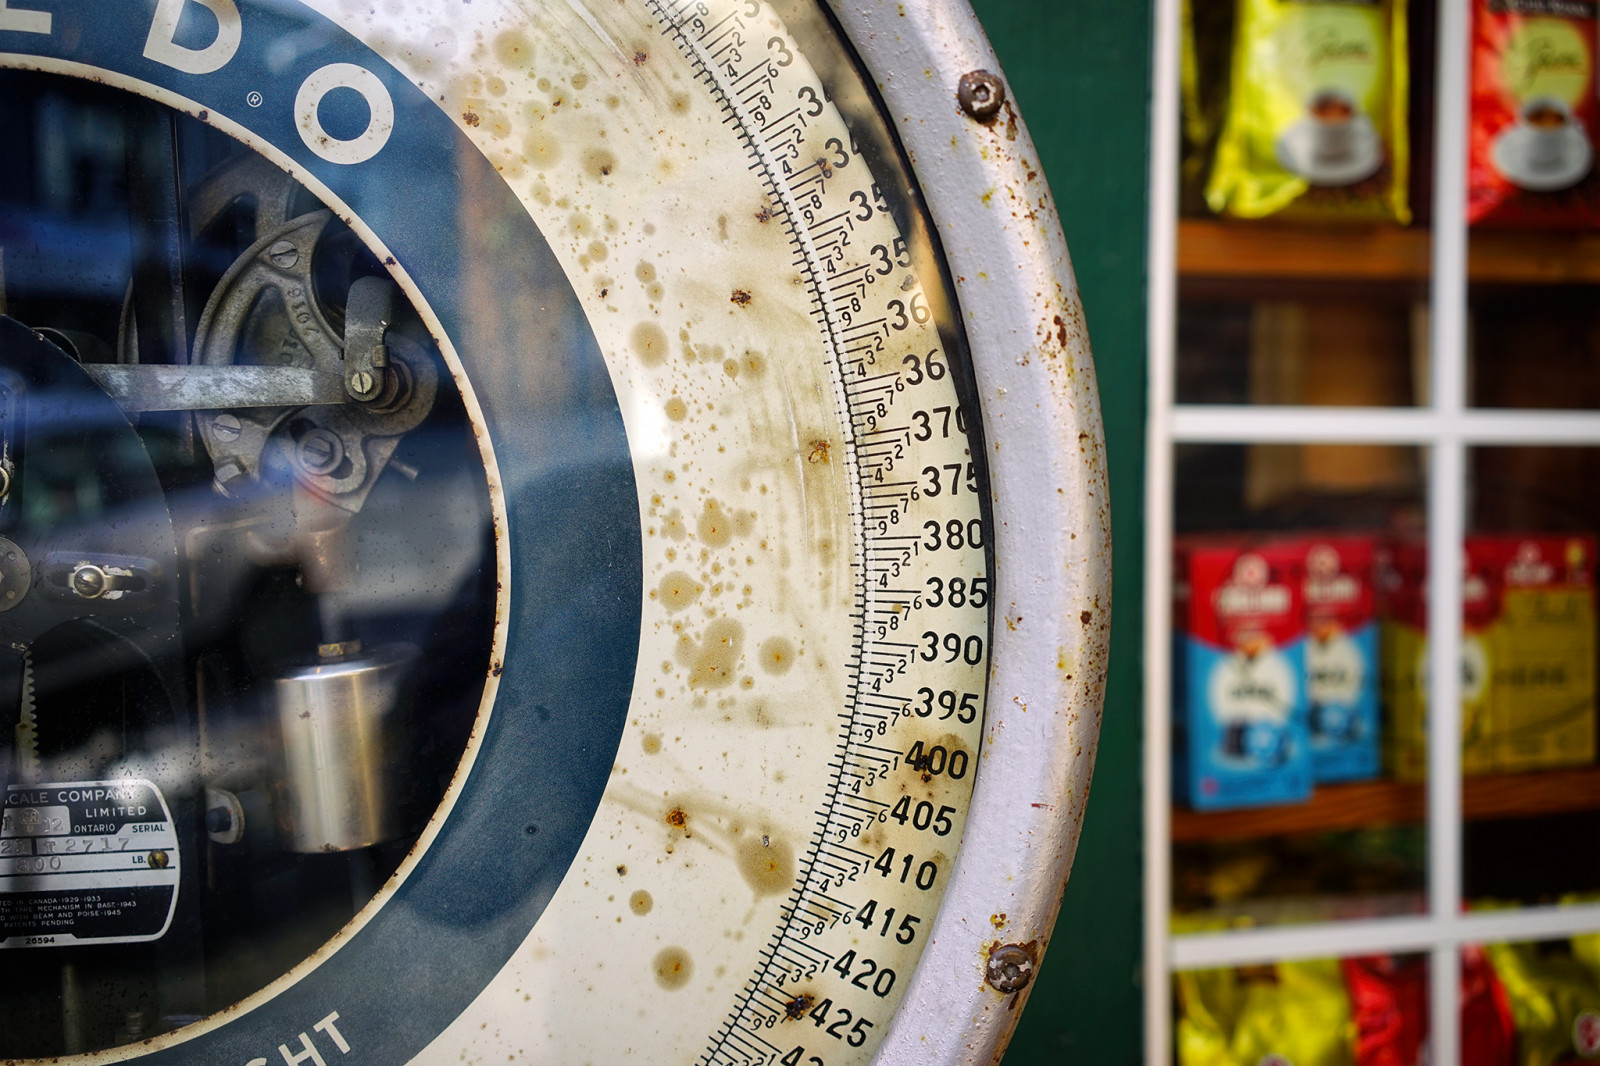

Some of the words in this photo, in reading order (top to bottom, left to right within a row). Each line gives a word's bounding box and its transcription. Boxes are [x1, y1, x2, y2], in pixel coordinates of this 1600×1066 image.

[697, 3, 709, 16] 8
[693, 18, 705, 33] 9
[735, 16, 745, 29] 1
[732, 31, 745, 47] 2
[730, 48, 742, 62] 3
[727, 63, 738, 78] 4
[767, 63, 779, 78] 6
[762, 79, 774, 94] 7
[759, 95, 772, 110] 8
[754, 111, 766, 126] 9
[798, 114, 807, 127] 1
[792, 128, 805, 144] 2
[787, 144, 799, 159] 3
[783, 160, 792, 174] 4
[816, 179, 825, 194] 7
[811, 194, 822, 209] 8
[804, 210, 814, 225] 9
[845, 217, 854, 231] 1
[839, 231, 850, 246] 2
[833, 245, 843, 260] 3
[826, 259, 836, 274] 4
[865, 268, 875, 284] 6
[857, 284, 866, 299] 7
[851, 297, 861, 312] 8
[887, 293, 932, 330] 36
[842, 312, 852, 326] 9
[883, 323, 890, 337] 1
[874, 336, 884, 351] 2
[865, 350, 875, 365] 3
[858, 363, 866, 378] 4
[902, 348, 945, 386] 36
[895, 377, 905, 392] 6
[885, 390, 894, 405] 7
[877, 403, 886, 418] 8
[867, 415, 876, 430] 9
[905, 431, 911, 446] 1
[894, 444, 904, 459] 2
[884, 456, 894, 471] 3
[875, 468, 884, 483] 4
[911, 486, 920, 501] 6
[900, 498, 909, 513] 7
[890, 509, 899, 524] 8
[878, 521, 887, 535] 9
[923, 519, 985, 551] 380
[913, 541, 919, 556] 1
[902, 551, 911, 566] 2
[891, 562, 900, 577] 3
[879, 573, 888, 588] 4
[925, 576, 988, 608] 385
[913, 595, 922, 610] 6
[902, 606, 911, 621] 7
[889, 616, 899, 630] 8
[878, 625, 886, 640] 9
[910, 648, 915, 663] 1
[920, 631, 983, 666] 390
[897, 659, 907, 674] 2
[885, 668, 894, 683] 3
[872, 677, 881, 693] 4
[902, 703, 911, 717] 6
[914, 687, 979, 724] 395
[891, 711, 900, 726] 7
[864, 728, 873, 743] 9
[877, 721, 887, 735] 8
[893, 756, 899, 771] 1
[904, 740, 969, 780] 400
[879, 764, 889, 779] 2
[852, 780, 861, 794] 4
[865, 772, 875, 787] 3
[5, 791, 49, 805] CALE
[58, 788, 136, 803] COMPANY
[85, 806, 147, 818] LIMITED
[878, 809, 888, 823] 6
[890, 795, 956, 836] 405
[74, 823, 116, 833] ONTARIO
[132, 824, 165, 833] SERIAL
[851, 823, 861, 837] 8
[866, 815, 875, 830] 7
[838, 829, 847, 843] 9
[132, 856, 146, 864] LB.
[864, 860, 870, 874] 1
[848, 866, 859, 881] 2
[874, 847, 937, 891] 410
[819, 878, 830, 893] 4
[834, 873, 845, 887] 3
[33, 912, 54, 920] BEAM
[41, 919, 75, 927] PENDING
[829, 914, 840, 929] 7
[842, 911, 853, 924] 6
[855, 899, 921, 945] 415
[800, 927, 811, 940] 9
[814, 921, 825, 935] 8
[25, 936, 55, 945] 26594
[805, 964, 817, 980] 2
[821, 959, 830, 973] 1
[833, 949, 896, 998] 420
[775, 973, 787, 987] 4
[791, 969, 802, 983] 3
[750, 1018, 762, 1031] 9
[765, 1014, 777, 1028] 8
[809, 998, 874, 1047] 425
